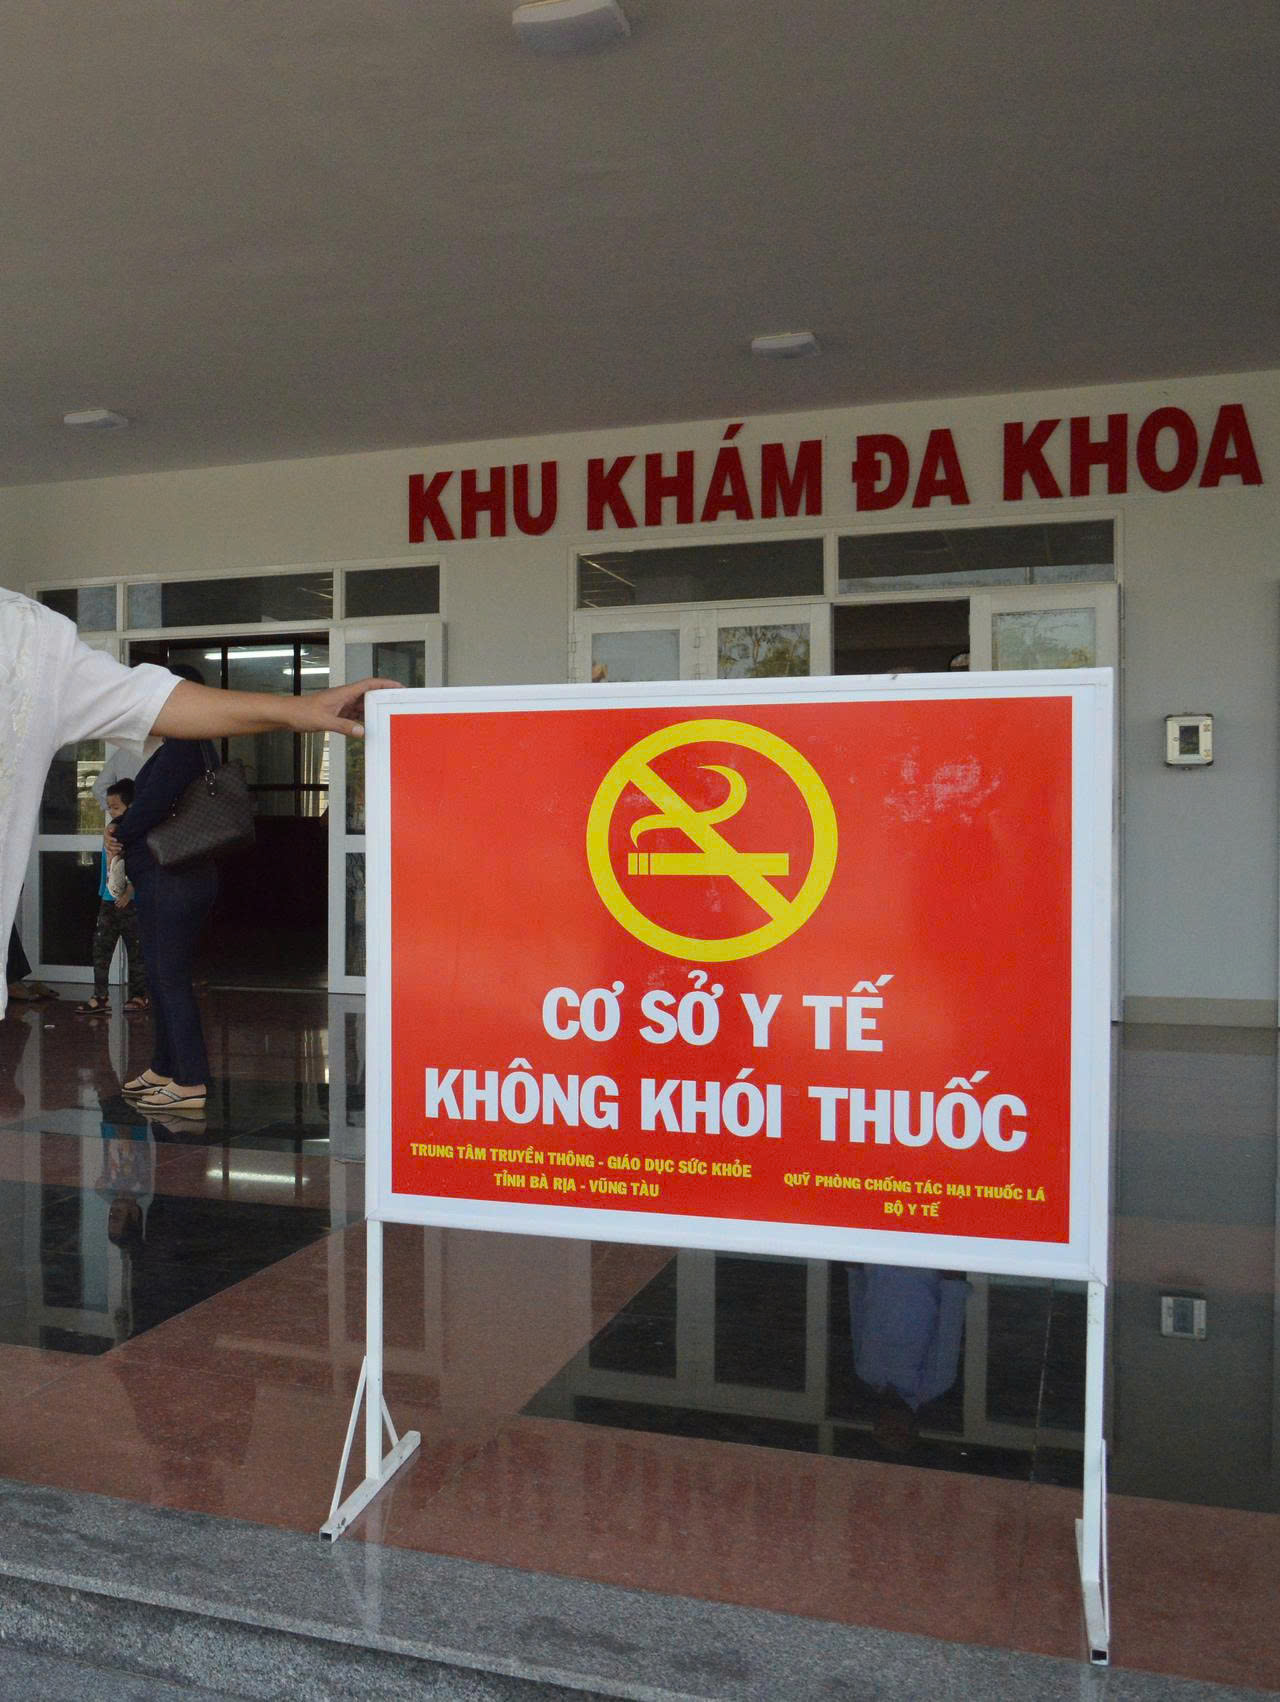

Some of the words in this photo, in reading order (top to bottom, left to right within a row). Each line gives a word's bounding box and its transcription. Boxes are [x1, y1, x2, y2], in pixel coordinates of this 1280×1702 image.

[409, 460, 558, 543] KHU
[587, 423, 823, 530] KHÁM
[852, 428, 969, 512] ĐA
[1003, 404, 1263, 500] KHOA
[541, 980, 625, 1042] CƠ
[639, 969, 725, 1046] SỞ
[739, 993, 783, 1048] Y
[802, 974, 895, 1052] TẾ
[425, 1057, 620, 1130] KHÔNG
[640, 1068, 782, 1139] KHÓI
[807, 1070, 1028, 1153] THUỐC
[410, 1143, 454, 1159] TRUNG
[457, 1144, 487, 1161] TÂM
[490, 1145, 544, 1164] TRUYỀN
[547, 1150, 595, 1168] THÔNG
[608, 1154, 641, 1171] GIÁO
[645, 1158, 675, 1175] DỤC
[678, 1157, 707, 1175] SỨC
[711, 1159, 753, 1178] KHỎE
[494, 1170, 526, 1187] TỈNH
[530, 1173, 549, 1190] BÀ
[553, 1177, 577, 1193] RỊA
[589, 1177, 628, 1195] VŨNG
[631, 1179, 660, 1197] TÀU
[784, 1171, 811, 1187] QUỸ
[815, 1173, 861, 1190] PHÒNG
[864, 1176, 912, 1193] CHỐNG
[914, 1179, 943, 1195] TÁC
[946, 1183, 971, 1199] HẠI
[974, 1183, 1023, 1200] THUỐC
[1027, 1186, 1046, 1201] LÁ
[884, 1199, 904, 1216] BỘ
[907, 1203, 917, 1216] Y
[921, 1201, 941, 1217] TẾ
